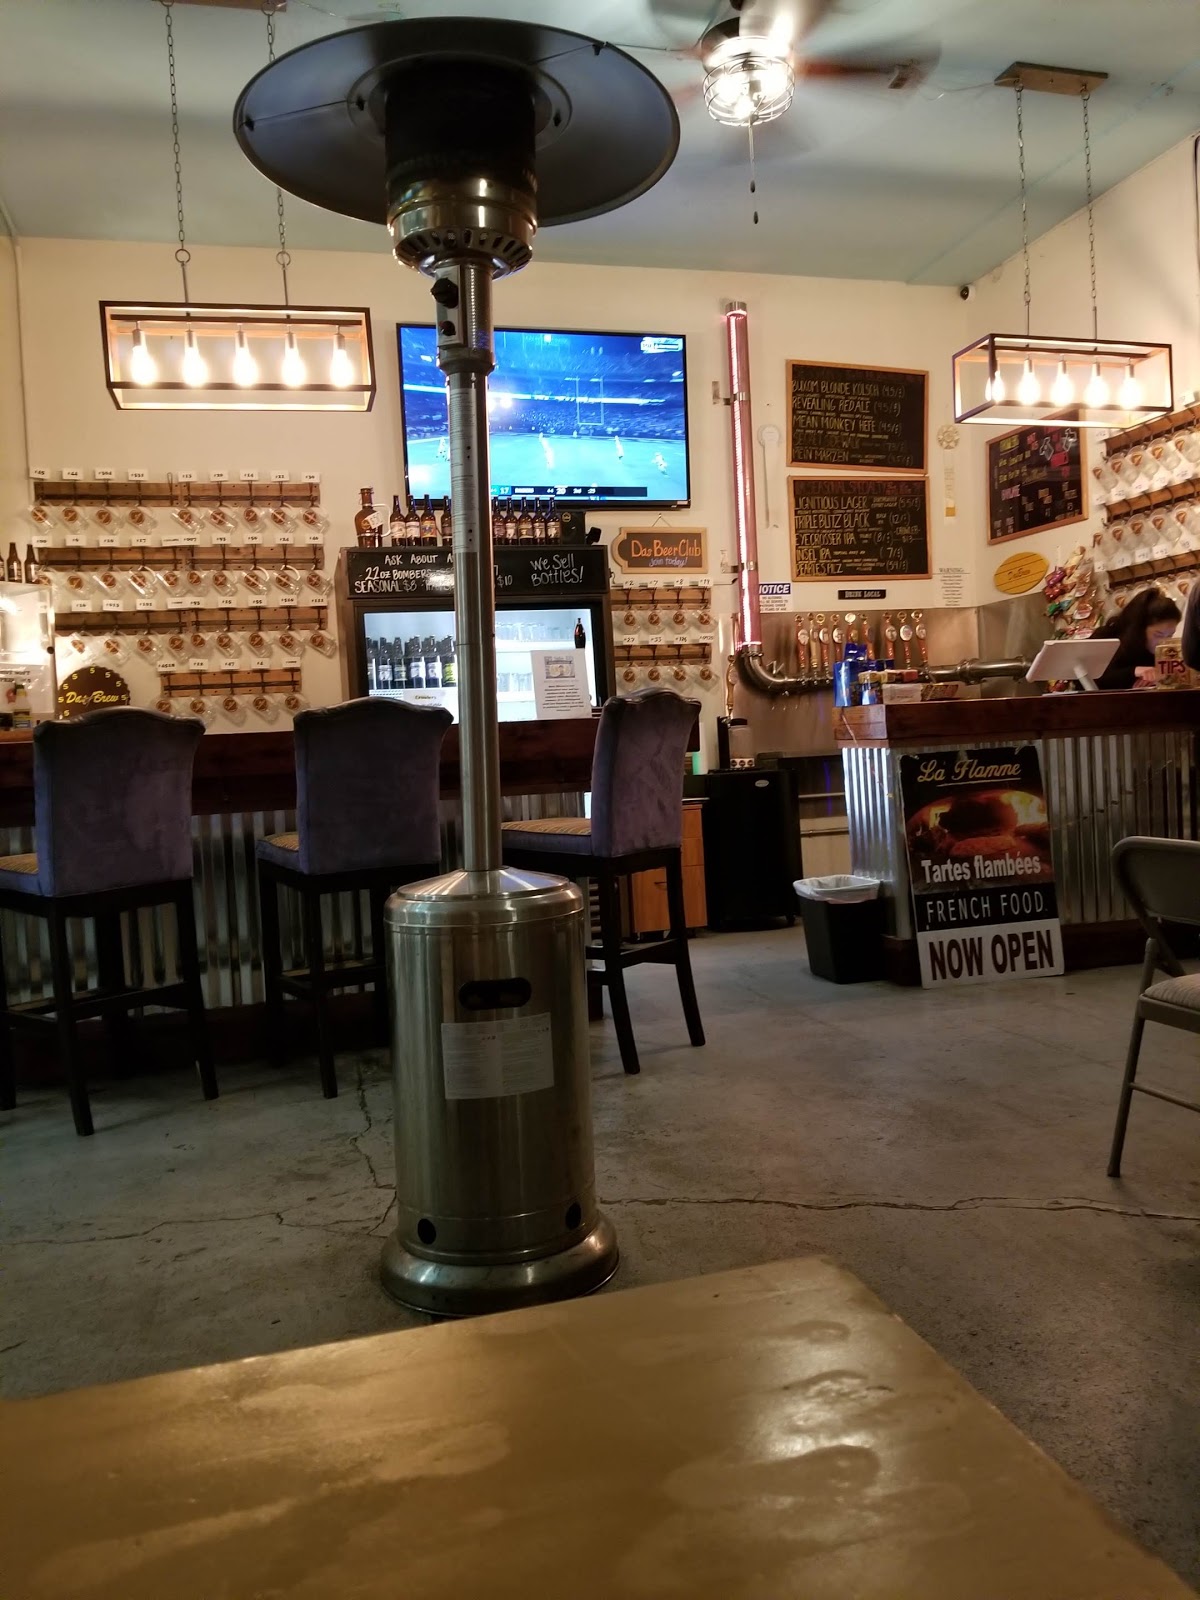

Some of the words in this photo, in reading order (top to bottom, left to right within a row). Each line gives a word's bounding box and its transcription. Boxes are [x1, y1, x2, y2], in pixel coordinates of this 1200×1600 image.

[820, 380, 851, 395] BLONDE
[792, 396, 836, 411] REVEALING
[793, 414, 820, 429] MEAN
[820, 416, 857, 432] MONKEY
[840, 496, 868, 510] LAGER
[794, 514, 818, 529] TRIPLE
[843, 512, 871, 528] BLACK
[631, 539, 652, 557] Das
[653, 539, 678, 557] Beer
[678, 539, 701, 557] Club
[384, 554, 403, 566] ASK
[410, 553, 438, 565] ABOUT
[530, 557, 550, 570] We
[552, 553, 574, 570] Sell
[665, 556, 688, 567] today!
[392, 568, 432, 580] BOMBERS
[354, 580, 403, 593] SEASONAL
[497, 574, 513, 588] $10
[1157, 660, 1186, 675] TIPS
[917, 759, 946, 783] La
[951, 758, 1021, 781] Flamme
[921, 858, 970, 884] Tartes
[974, 851, 1041, 877] flambées
[926, 896, 991, 924] FRENCH
[1000, 890, 1044, 916] FOOD
[928, 936, 984, 981] NOW
[991, 929, 1054, 974] OPEN
